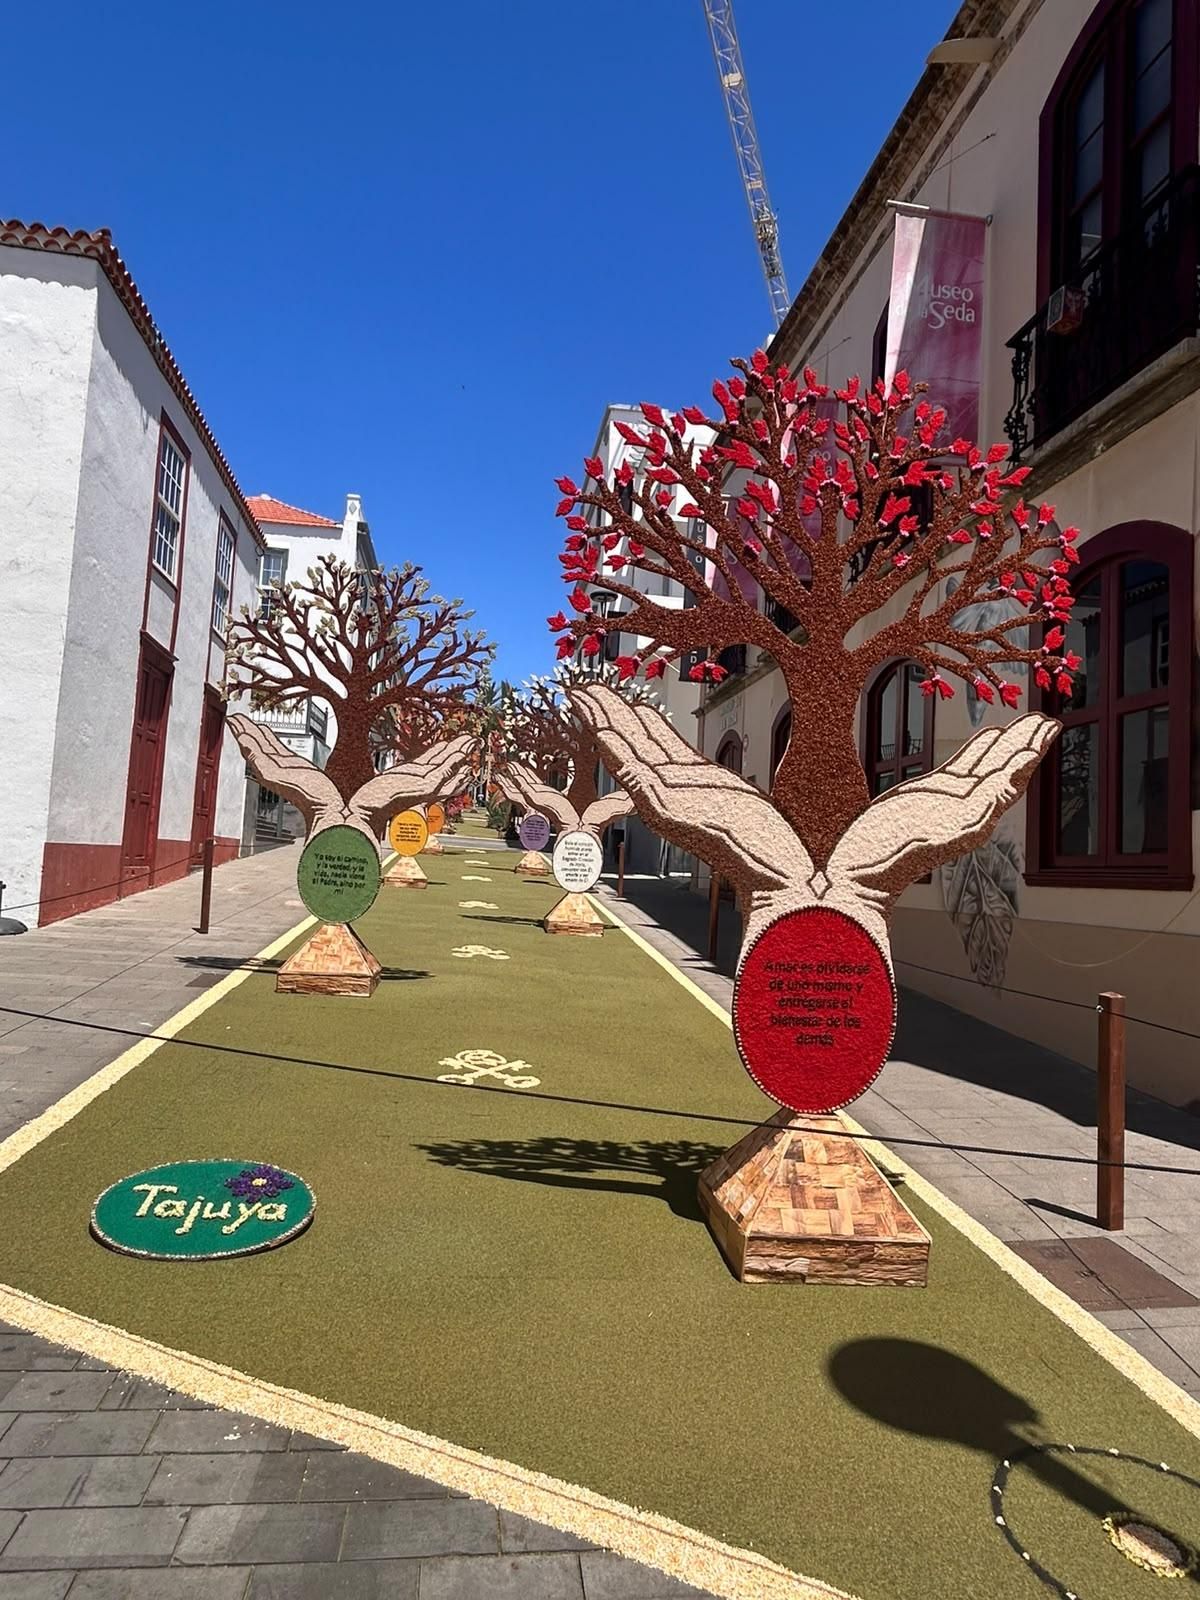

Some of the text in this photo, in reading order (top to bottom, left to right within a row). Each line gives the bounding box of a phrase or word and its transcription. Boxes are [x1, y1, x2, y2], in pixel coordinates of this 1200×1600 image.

[928, 301, 975, 329] Seda
[799, 963, 814, 971] es
[769, 978, 864, 992] de uno mismo y
[778, 997, 839, 1011] entregarse
[826, 1016, 841, 1027] de
[132, 1183, 288, 1235] Tajuya
